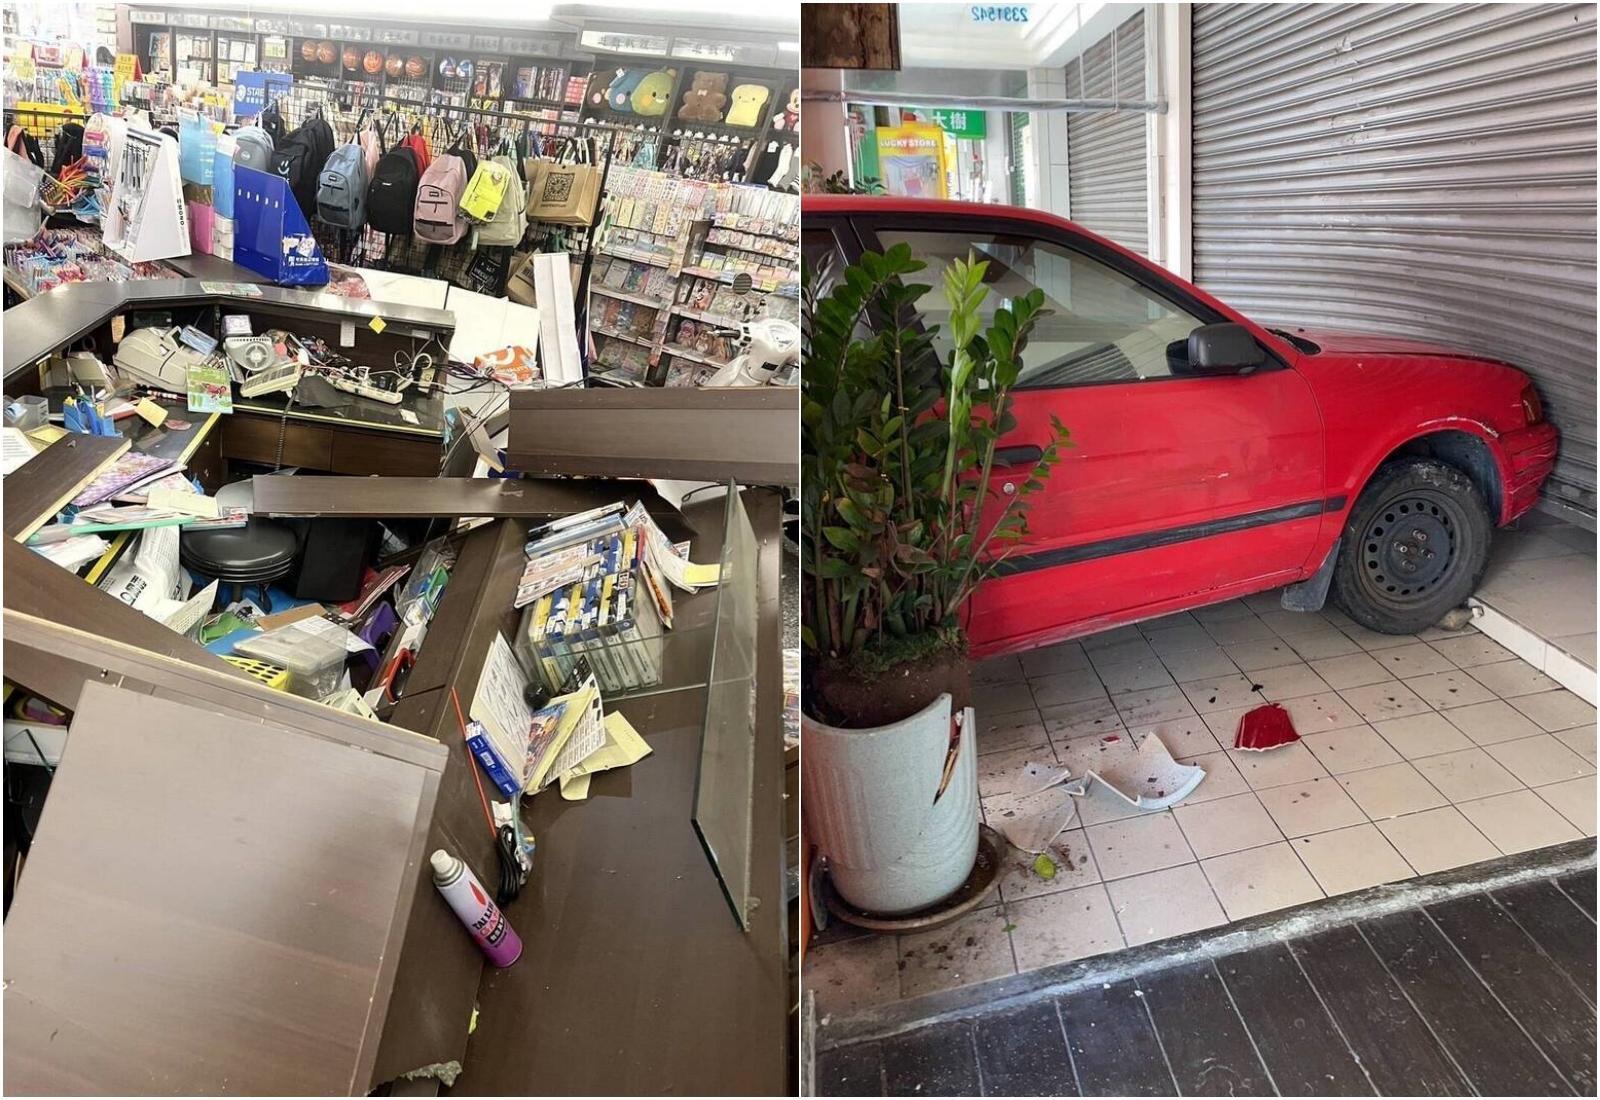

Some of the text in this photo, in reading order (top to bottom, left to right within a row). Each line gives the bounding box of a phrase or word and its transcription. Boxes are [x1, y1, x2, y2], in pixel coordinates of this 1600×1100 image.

[931, 111, 967, 131] 大樹
[880, 138, 936, 148] LUCKY STORE
